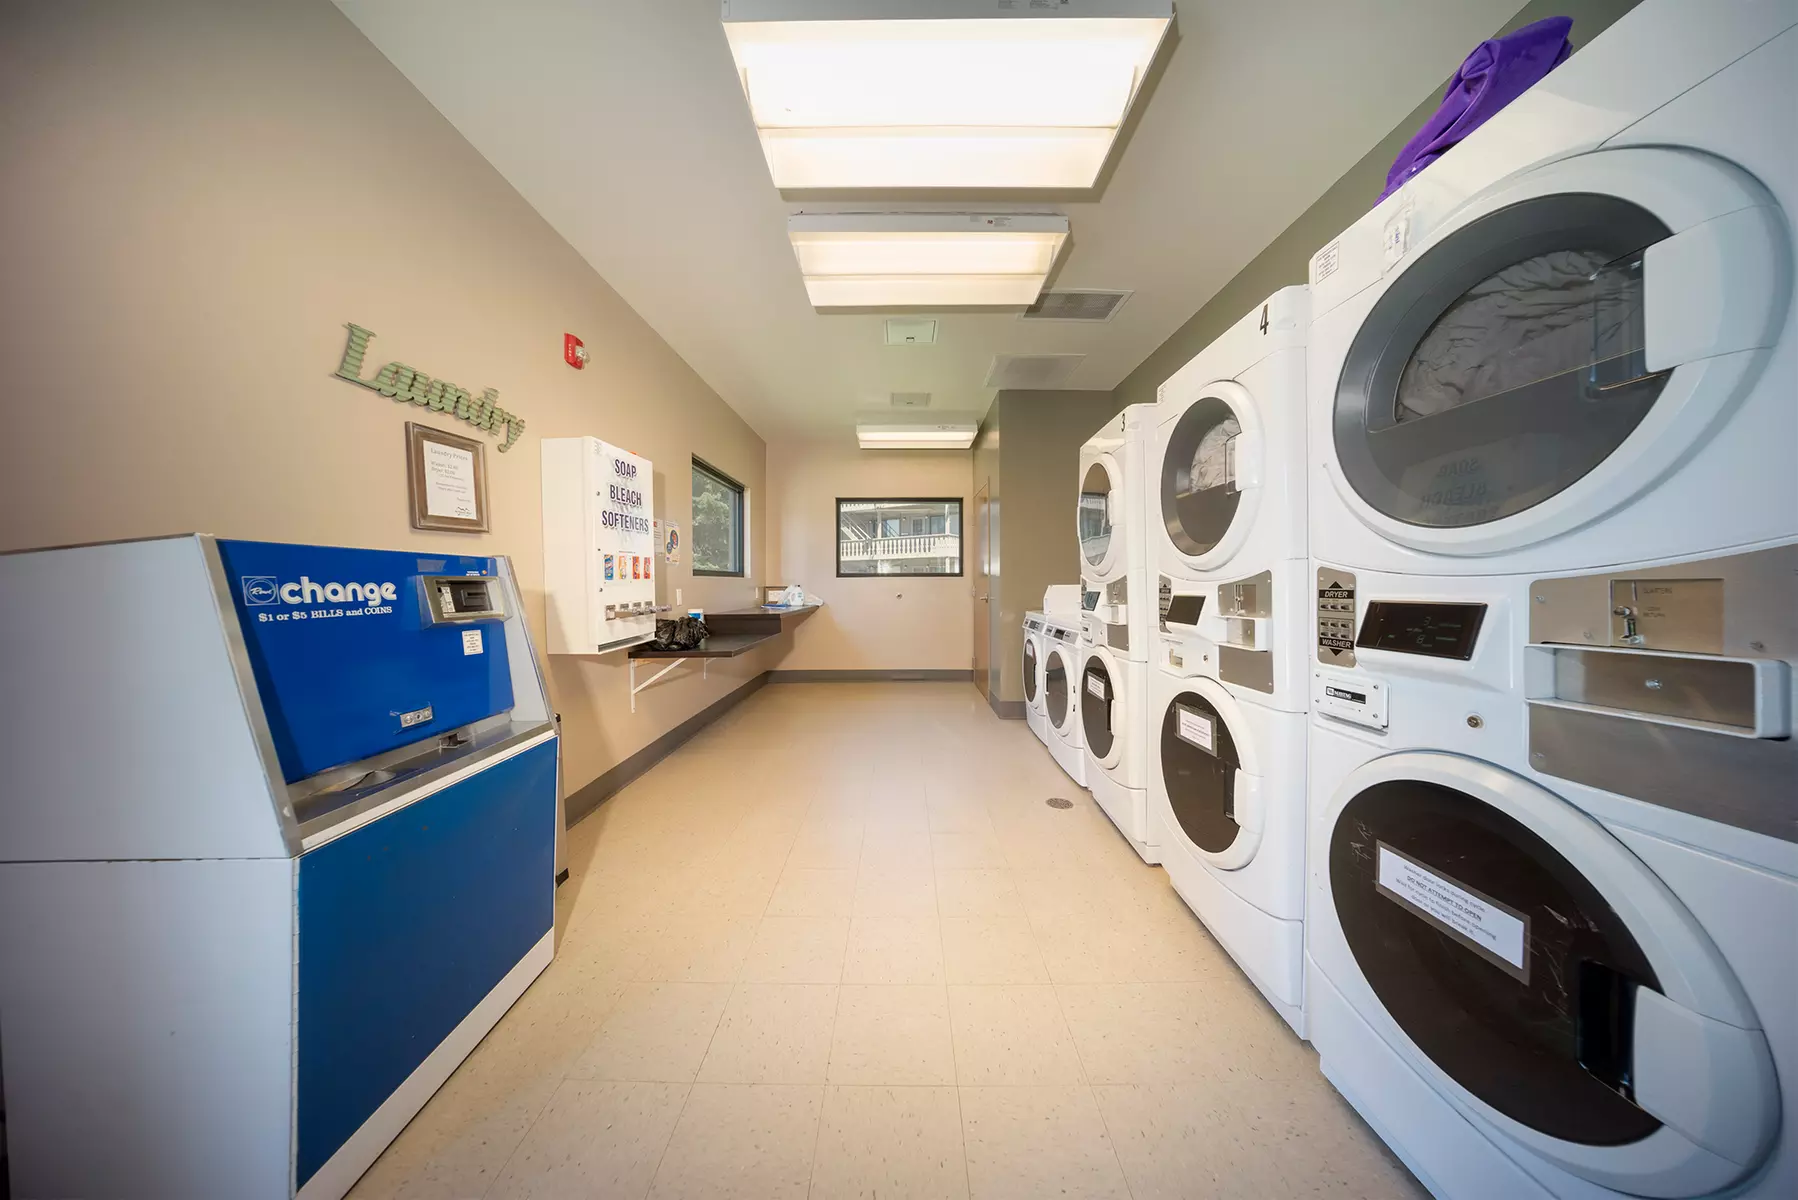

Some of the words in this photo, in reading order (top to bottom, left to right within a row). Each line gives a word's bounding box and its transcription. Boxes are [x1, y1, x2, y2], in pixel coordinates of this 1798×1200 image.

[1260, 303, 1269, 335] 4
[335, 322, 525, 453] Laundry
[614, 459, 637, 478] SOAP
[609, 484, 642, 506] BLEACH
[602, 510, 649, 533] SOFTENERS
[280, 576, 397, 607] change
[1324, 590, 1349, 599] DRYER
[258, 613, 274, 622] $1
[292, 611, 307, 620] $5
[311, 609, 344, 619] BILLS
[345, 608, 363, 616] and
[364, 606, 393, 615] COINS
[1321, 638, 1352, 649] WASHER
